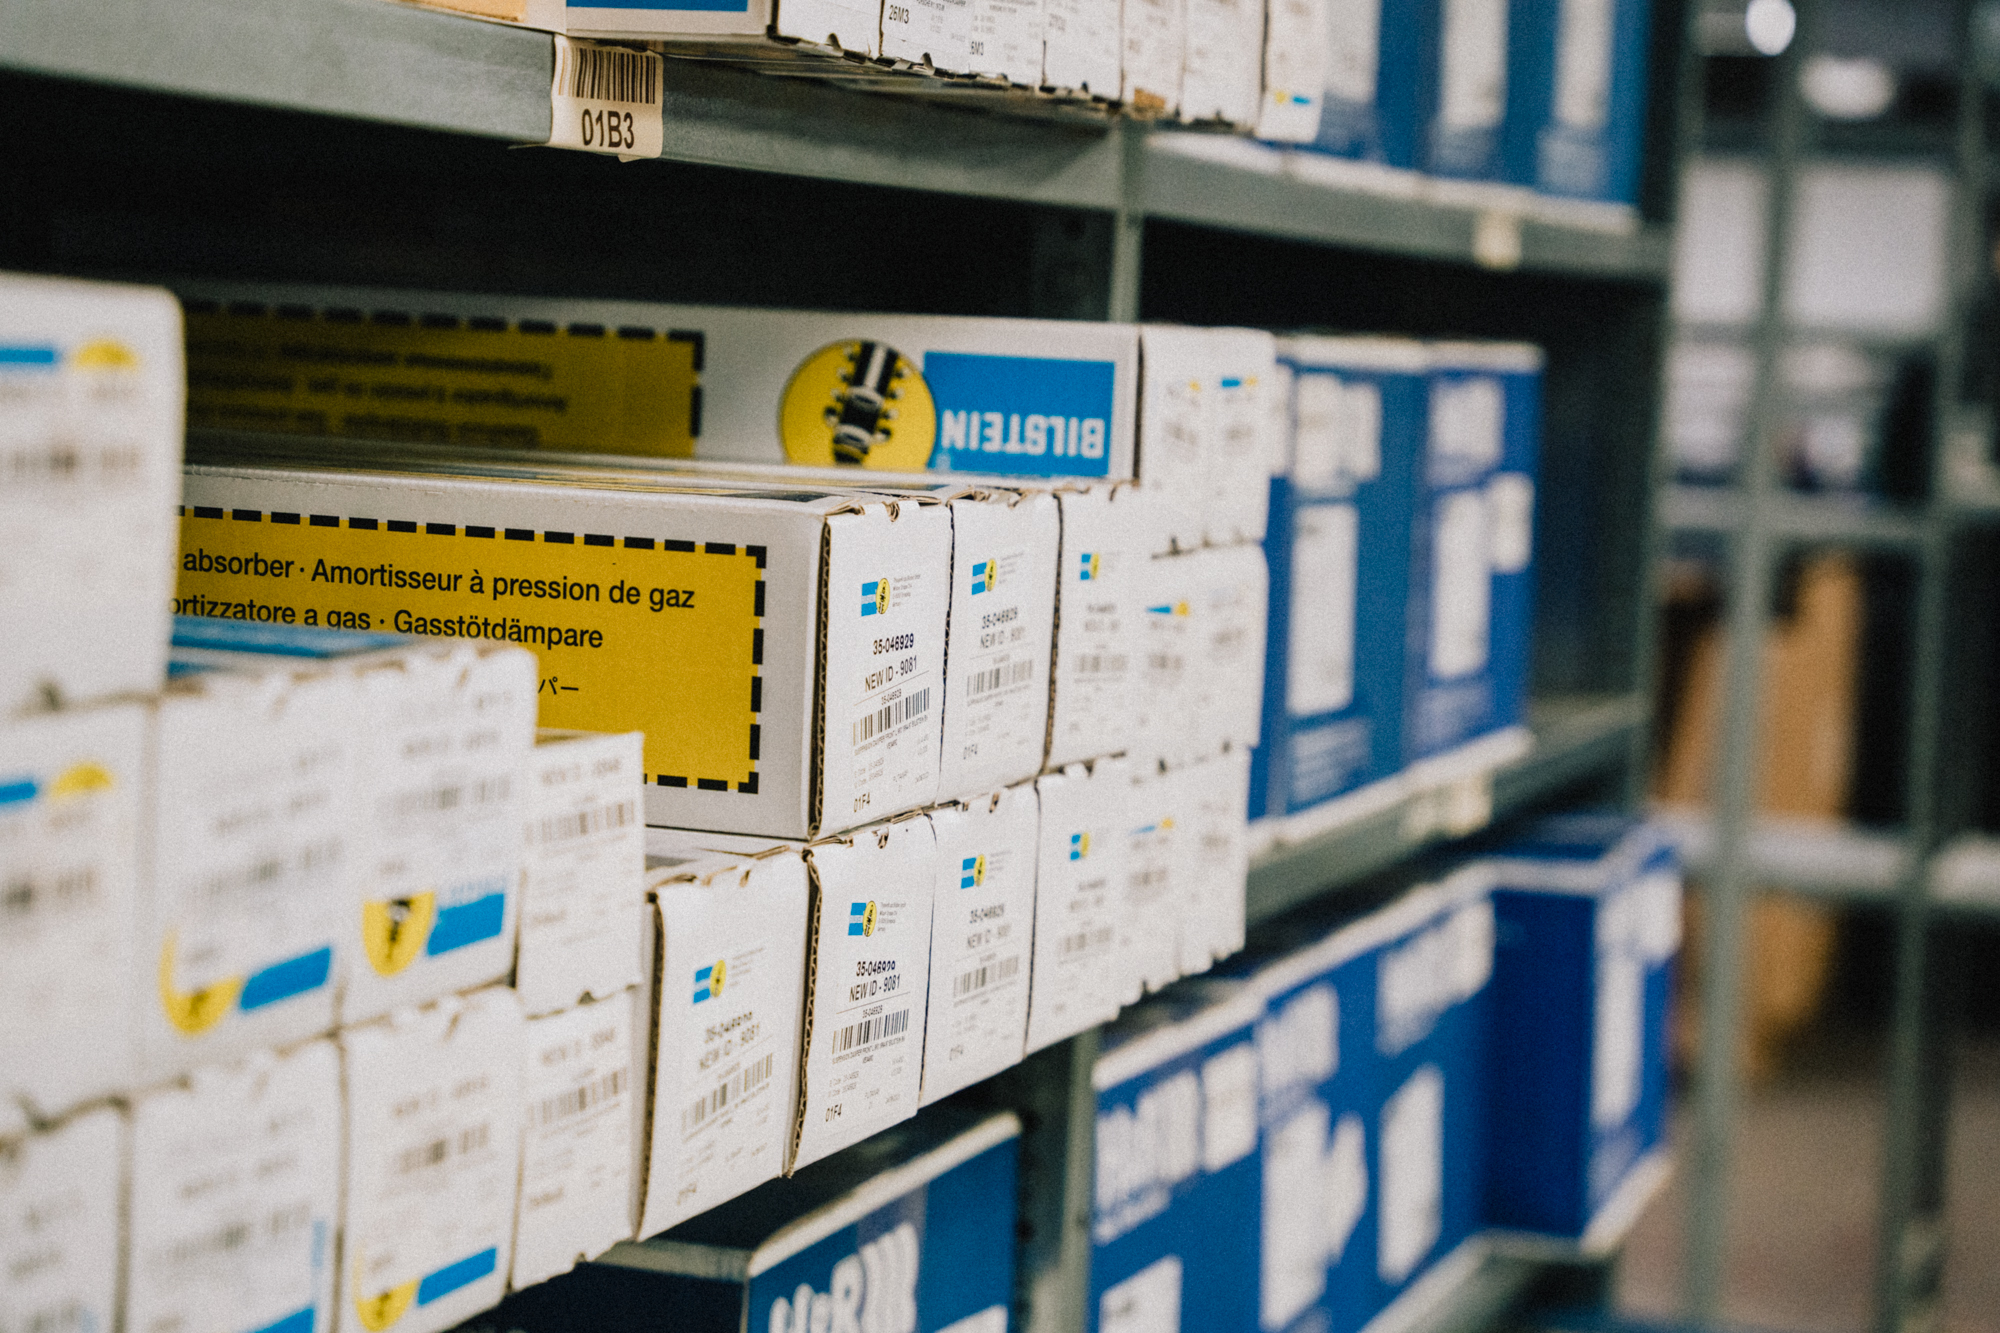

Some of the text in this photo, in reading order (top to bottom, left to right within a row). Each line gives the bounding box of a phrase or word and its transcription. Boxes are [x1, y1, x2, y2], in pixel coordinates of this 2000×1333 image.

[889, 4, 910, 25] 26M3
[969, 41, 984, 56] 6M3
[581, 108, 634, 149] 01B3
[940, 408, 1105, 460] BILSTEIN
[183, 548, 695, 613] absorber Amortisseur à pression de gaz
[303, 608, 318, 626] a
[394, 608, 604, 650] Gasstötdämpare
[873, 632, 915, 655] 35-046929
[865, 669, 884, 692] NEW
[885, 665, 894, 683] ID
[900, 654, 917, 676] 9081
[853, 792, 871, 813] 01F4
[849, 983, 868, 1003] NEW
[869, 979, 878, 997] ID
[883, 973, 901, 992] 9081
[825, 1103, 842, 1123] 01F4
